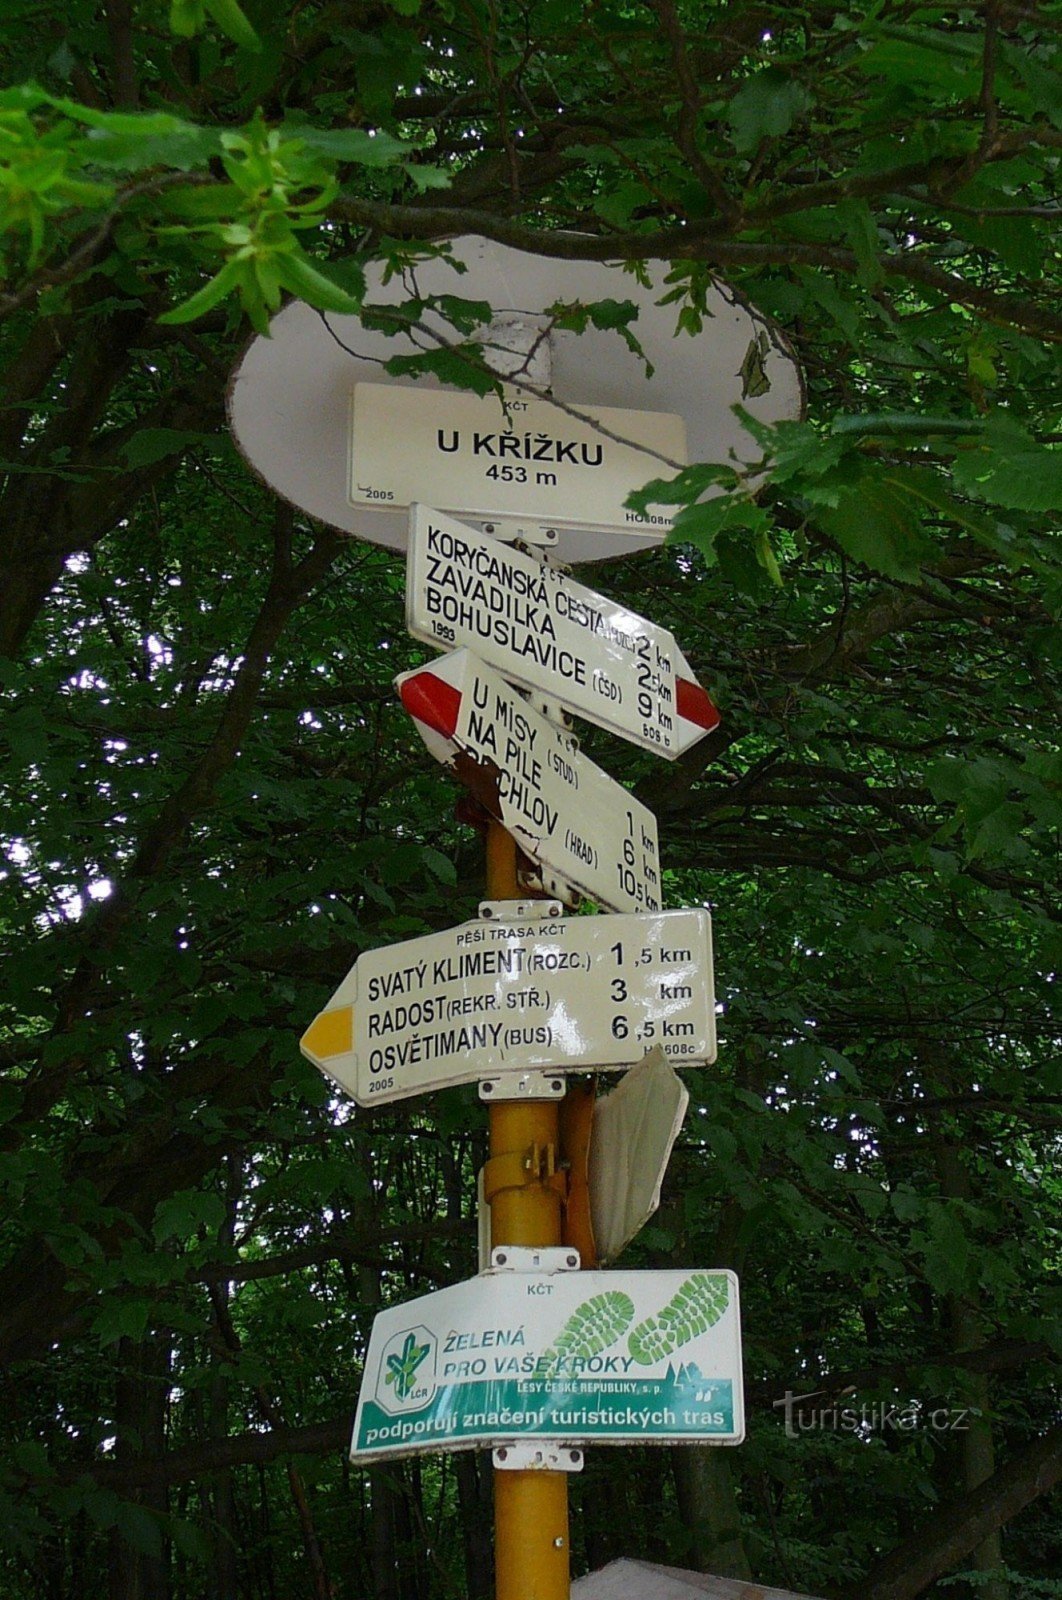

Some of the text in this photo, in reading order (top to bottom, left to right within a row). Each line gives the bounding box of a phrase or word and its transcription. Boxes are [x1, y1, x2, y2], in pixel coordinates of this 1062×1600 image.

[436, 429, 604, 467] U KŘÍŽKU
[485, 464, 557, 487] 453 m
[366, 489, 394, 501] 2005
[426, 555, 556, 641] ZAVADILKA
[428, 525, 550, 608] KORYČANSKÁ
[555, 591, 607, 634] CESTA
[636, 635, 651, 662] 2
[656, 645, 671, 673] km
[432, 620, 456, 642] 1993
[427, 586, 586, 686] BOHUSLAVICE
[638, 692, 652, 719] 9
[657, 702, 672, 731] km
[473, 677, 489, 710] U
[626, 811, 633, 837] 1
[641, 824, 655, 854] km
[467, 711, 657, 885] NA PILE 6 km
[466, 744, 559, 836] CHLOV
[564, 829, 598, 870] (HRAD)
[644, 884, 659, 912] km
[456, 923, 566, 946] PĚŠÍ TRASA KČT
[368, 959, 427, 1002] SVATÝ
[660, 947, 692, 963] km
[506, 987, 550, 1010] STŘ.)
[610, 978, 628, 1002] 3
[660, 983, 692, 999] km
[662, 1020, 695, 1037] km
[643, 1043, 696, 1055] H608c
[369, 1077, 394, 1093] 2005
[527, 1283, 554, 1295] KČT
[444, 1351, 634, 1378] PRO VAŠE KROKY
[517, 1382, 544, 1393] LESY
[544, 1381, 577, 1393] ČESKÉ
[366, 1406, 724, 1444] podporují značení turistických tras
